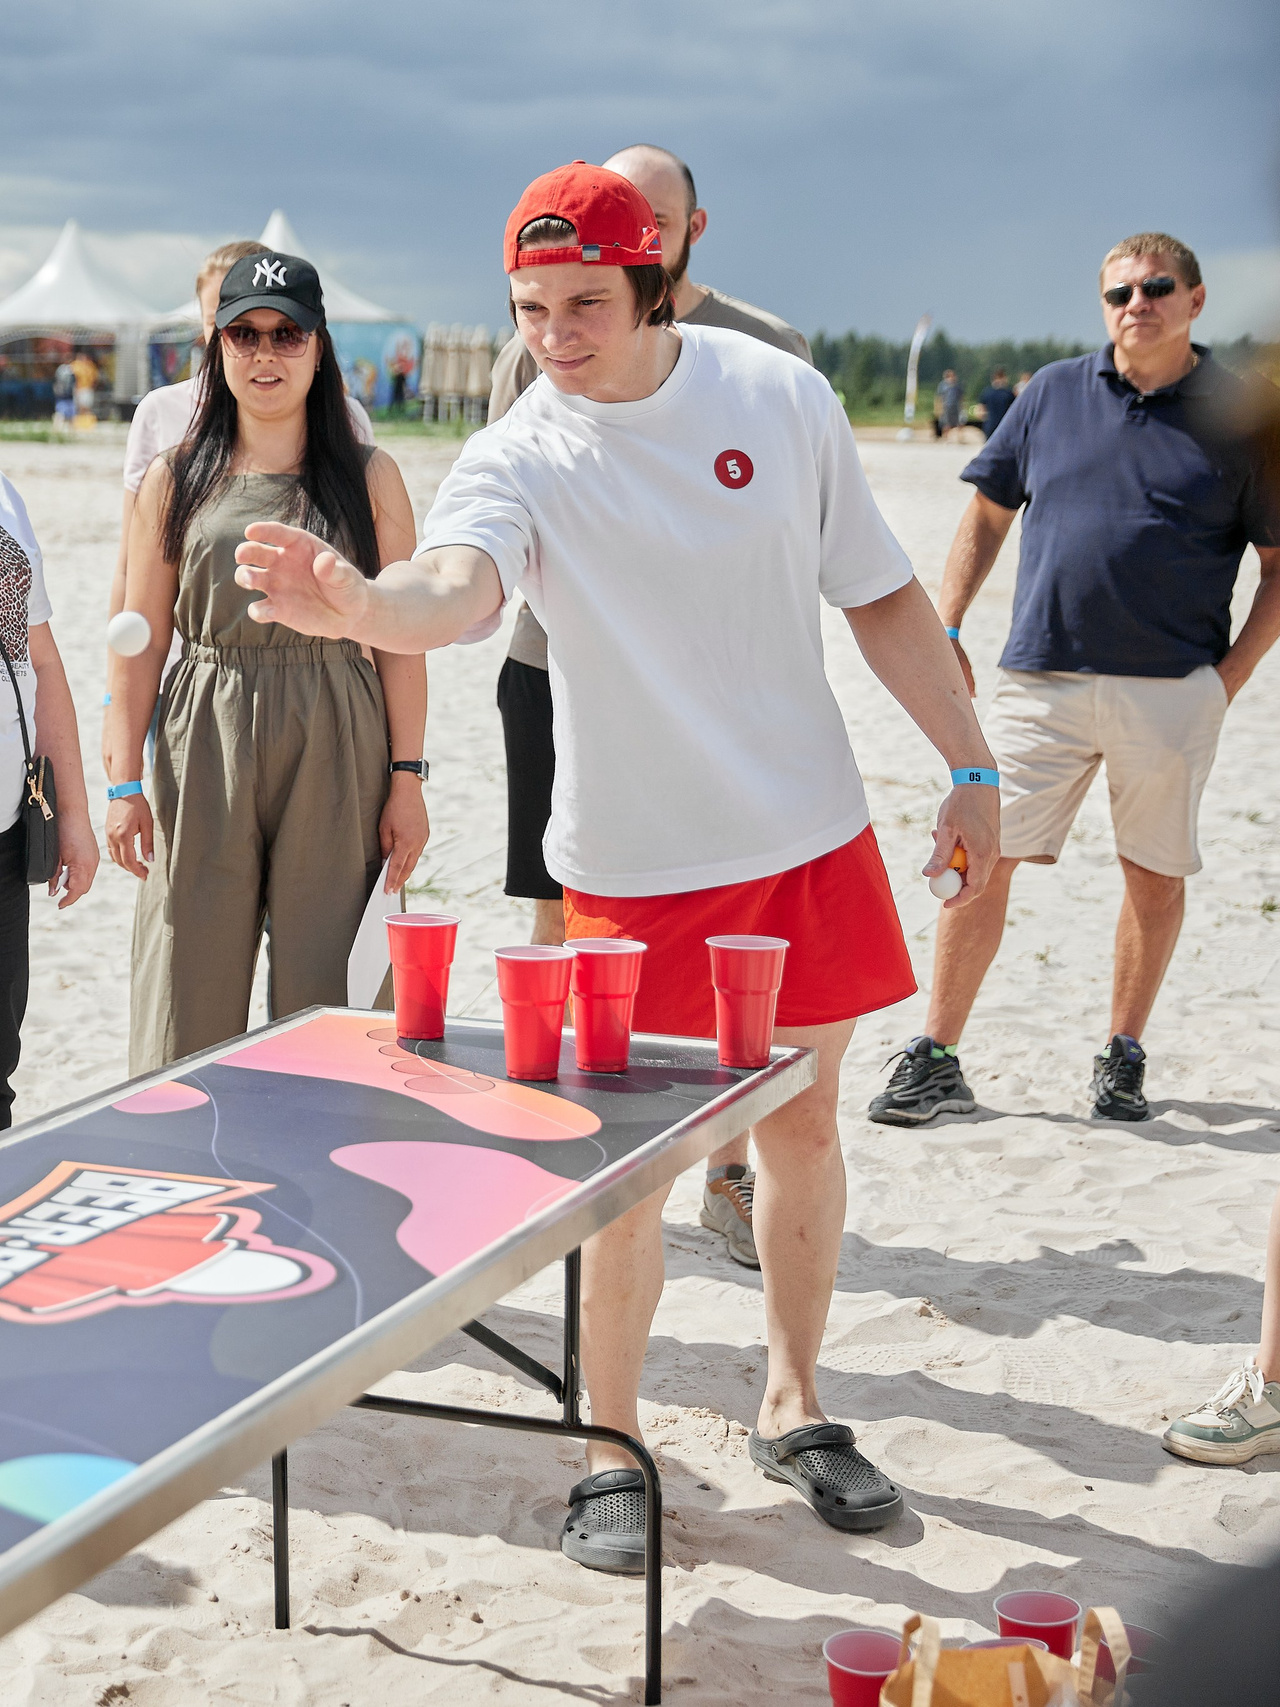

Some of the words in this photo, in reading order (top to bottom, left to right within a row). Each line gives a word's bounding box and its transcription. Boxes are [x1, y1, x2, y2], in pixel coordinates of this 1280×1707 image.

[252, 258, 288, 287] NY
[726, 458, 742, 480] 5
[968, 772, 981, 782] 05
